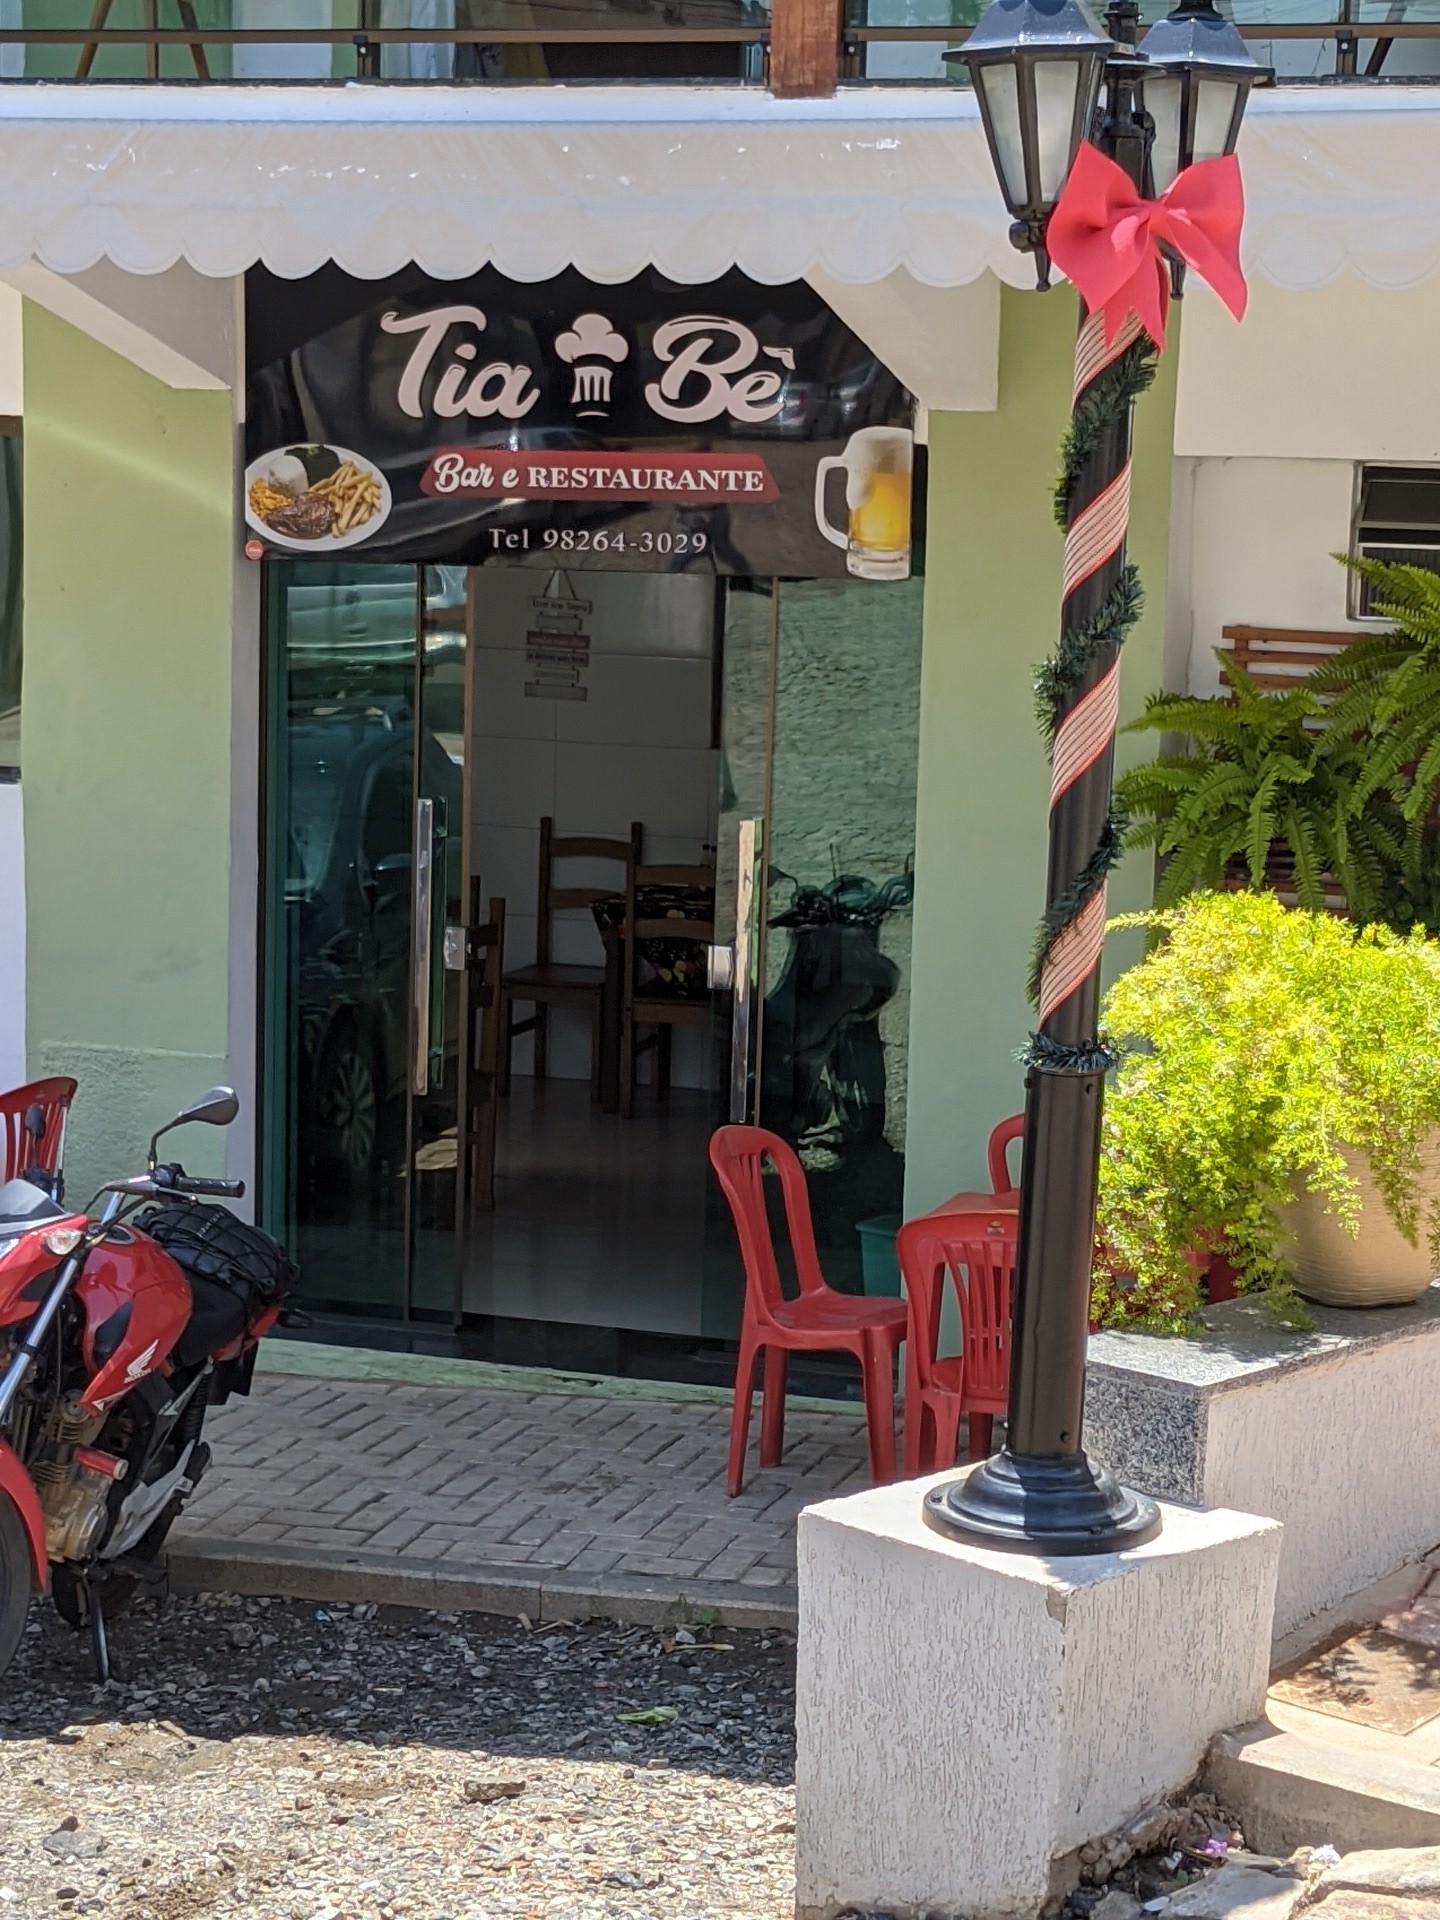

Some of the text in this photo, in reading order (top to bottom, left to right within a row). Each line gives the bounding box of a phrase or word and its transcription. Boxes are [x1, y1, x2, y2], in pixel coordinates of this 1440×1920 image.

[380, 305, 541, 419] Tia
[433, 453, 764, 493] Bar e RESTAURANTE
[488, 528, 707, 554] Tel 98264-3029
